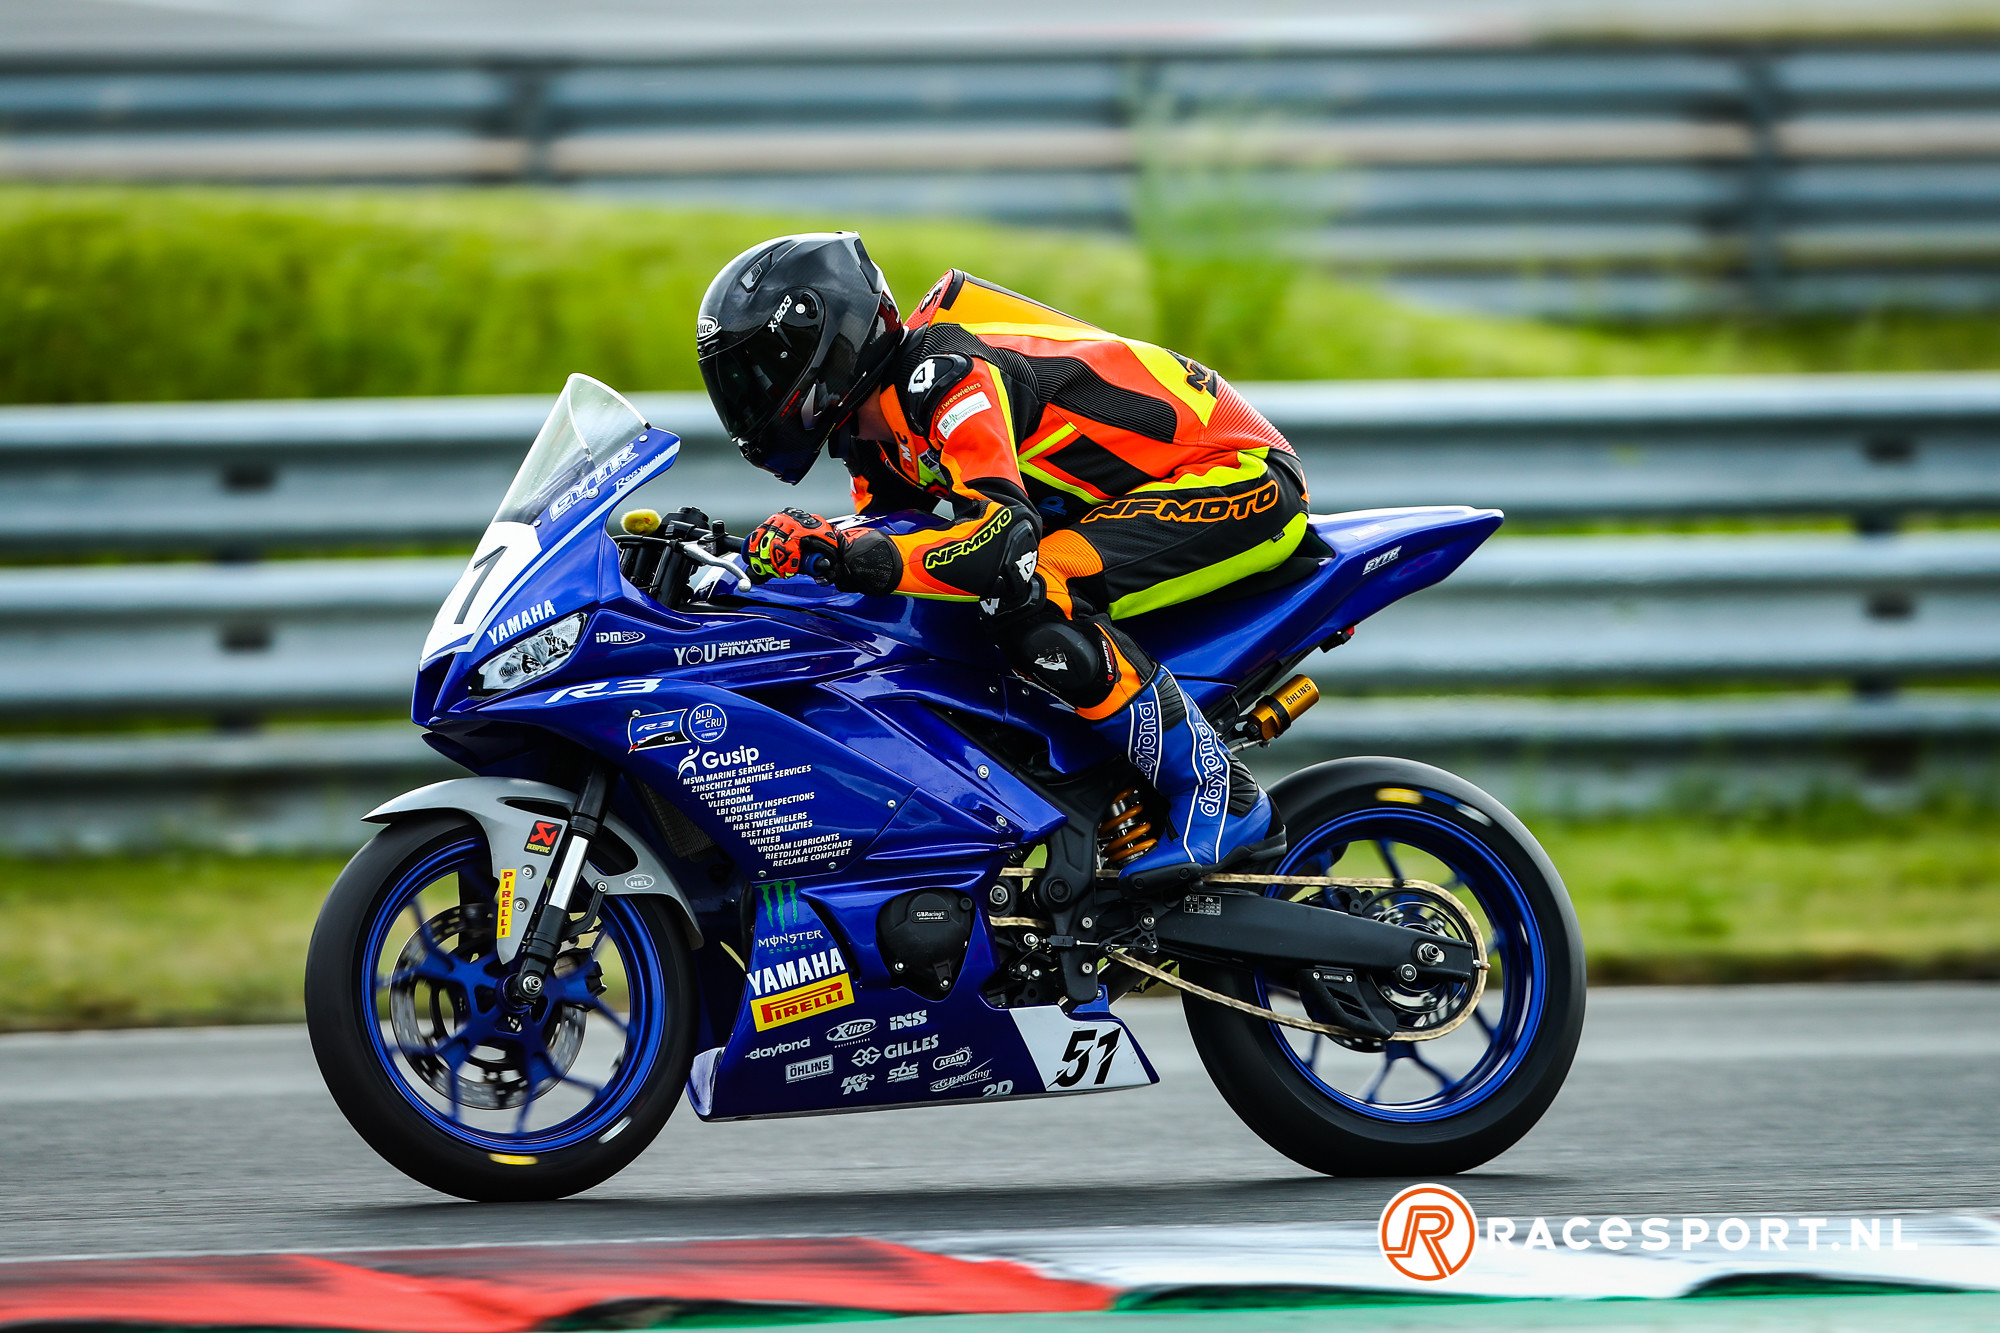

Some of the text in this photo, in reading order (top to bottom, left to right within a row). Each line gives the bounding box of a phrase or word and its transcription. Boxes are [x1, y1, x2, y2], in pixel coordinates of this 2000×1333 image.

[941, 382, 981, 410] Tweewielers
[550, 443, 636, 520] GYTR
[1080, 480, 1279, 523] NFMOTO
[925, 508, 1012, 569] NFMOTO
[1363, 546, 1401, 573] GYTR
[487, 600, 556, 645] YAMAHA
[674, 639, 790, 665] YOU FINANCE
[545, 678, 663, 704] R3
[636, 720, 675, 732] R3
[702, 745, 760, 769] Gusip
[683, 762, 775, 785] MSVA MARINE SERVICES
[691, 764, 812, 793] ZINSCHITZ MARITIME SERVICES
[1194, 721, 1228, 818] daytona
[699, 785, 751, 800] CVC TRADING
[708, 794, 754, 808] VLIERODAM
[716, 791, 815, 816] LBI QUALITY INSPECTIONS
[724, 808, 777, 824] MPD SERVICE
[732, 811, 808, 831] H&R TWEEWIELERS
[741, 820, 813, 838] BSET INSTALLATIES
[749, 835, 781, 846] WINTEB
[757, 832, 840, 853] VROOAM LUBRICANTS
[764, 839, 853, 860] RIETDIJK AUTOSCHADE
[773, 848, 851, 867] RECLAME COMPLEET
[630, 879, 650, 887] HEL
[501, 871, 514, 936] PIRELLI
[758, 930, 824, 948] MONSTER
[769, 943, 814, 954] ENERGY
[746, 948, 846, 996] YAMAHA
[761, 982, 845, 1023] PIRELLI
[834, 1023, 872, 1039] X-lite
[748, 1037, 811, 1059] daytona
[884, 1034, 939, 1059] GILLES
[1047, 1027, 1122, 1088] 51
[790, 1060, 830, 1077] ÖHLINS
[887, 1061, 919, 1081] sbs
[939, 1054, 964, 1067] AFAM
[840, 1073, 876, 1095] K&N
[982, 1080, 1014, 1098] 2D
